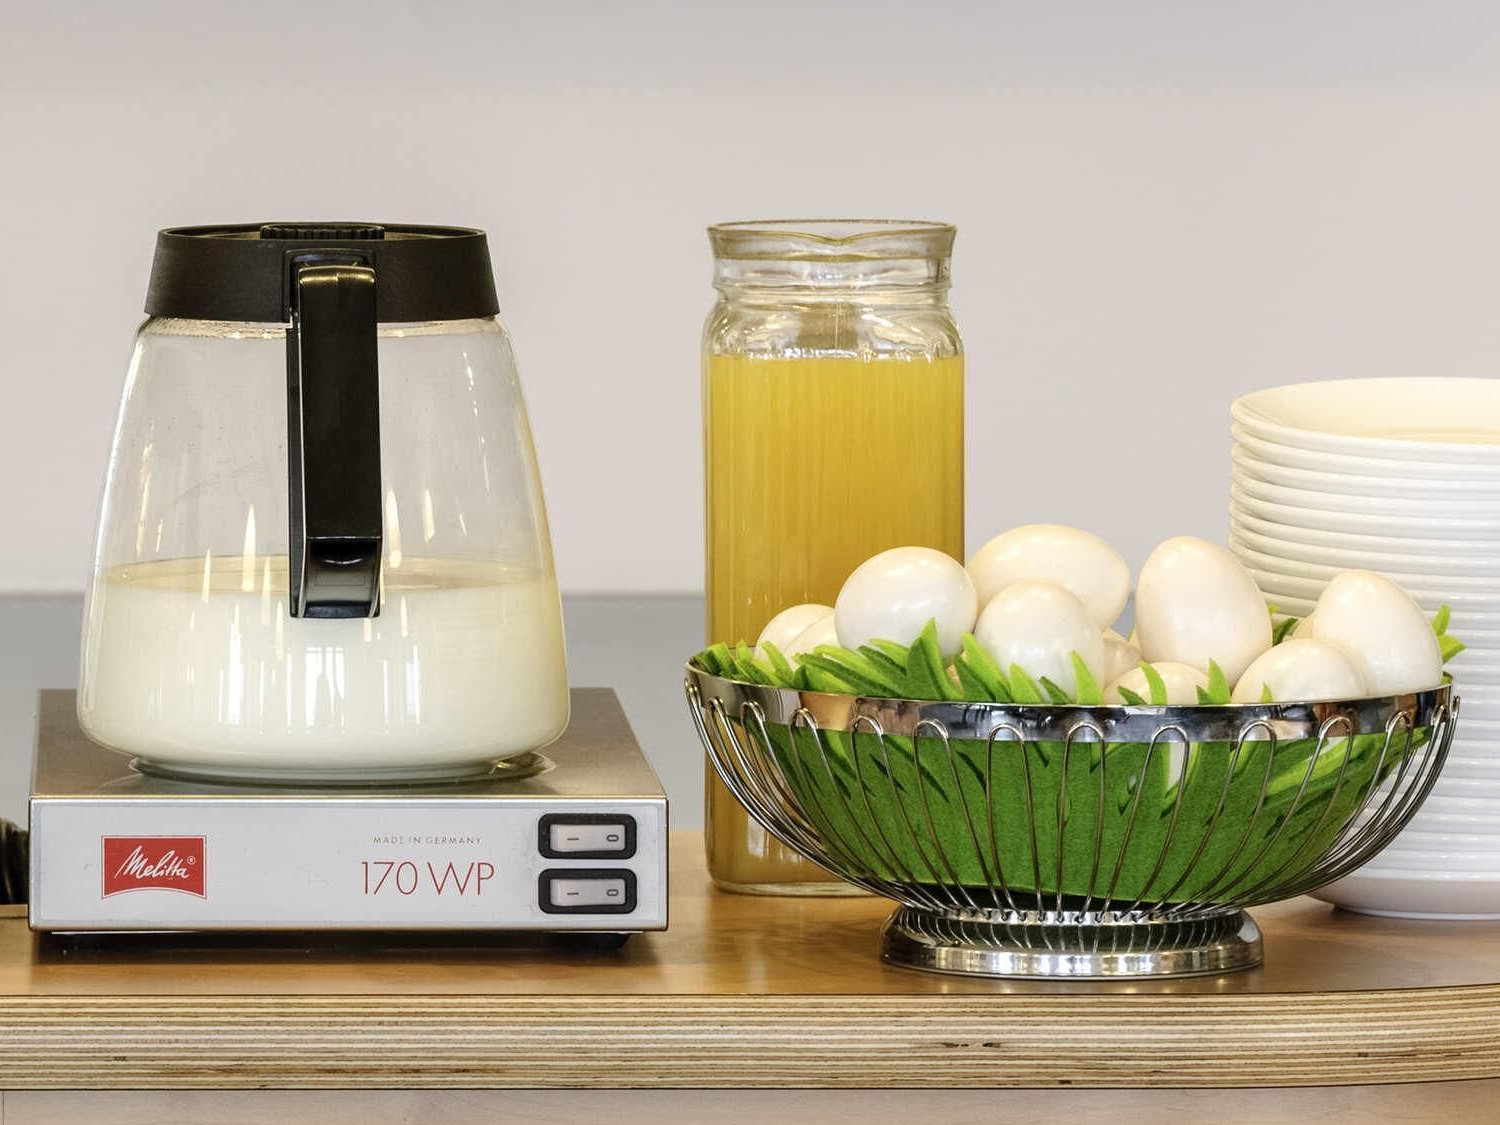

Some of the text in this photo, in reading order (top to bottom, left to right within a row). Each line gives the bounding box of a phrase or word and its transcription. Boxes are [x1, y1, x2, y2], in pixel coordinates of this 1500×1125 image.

[373, 836, 482, 845] MADE IN GERMANY
[361, 861, 495, 896] 170 WP
